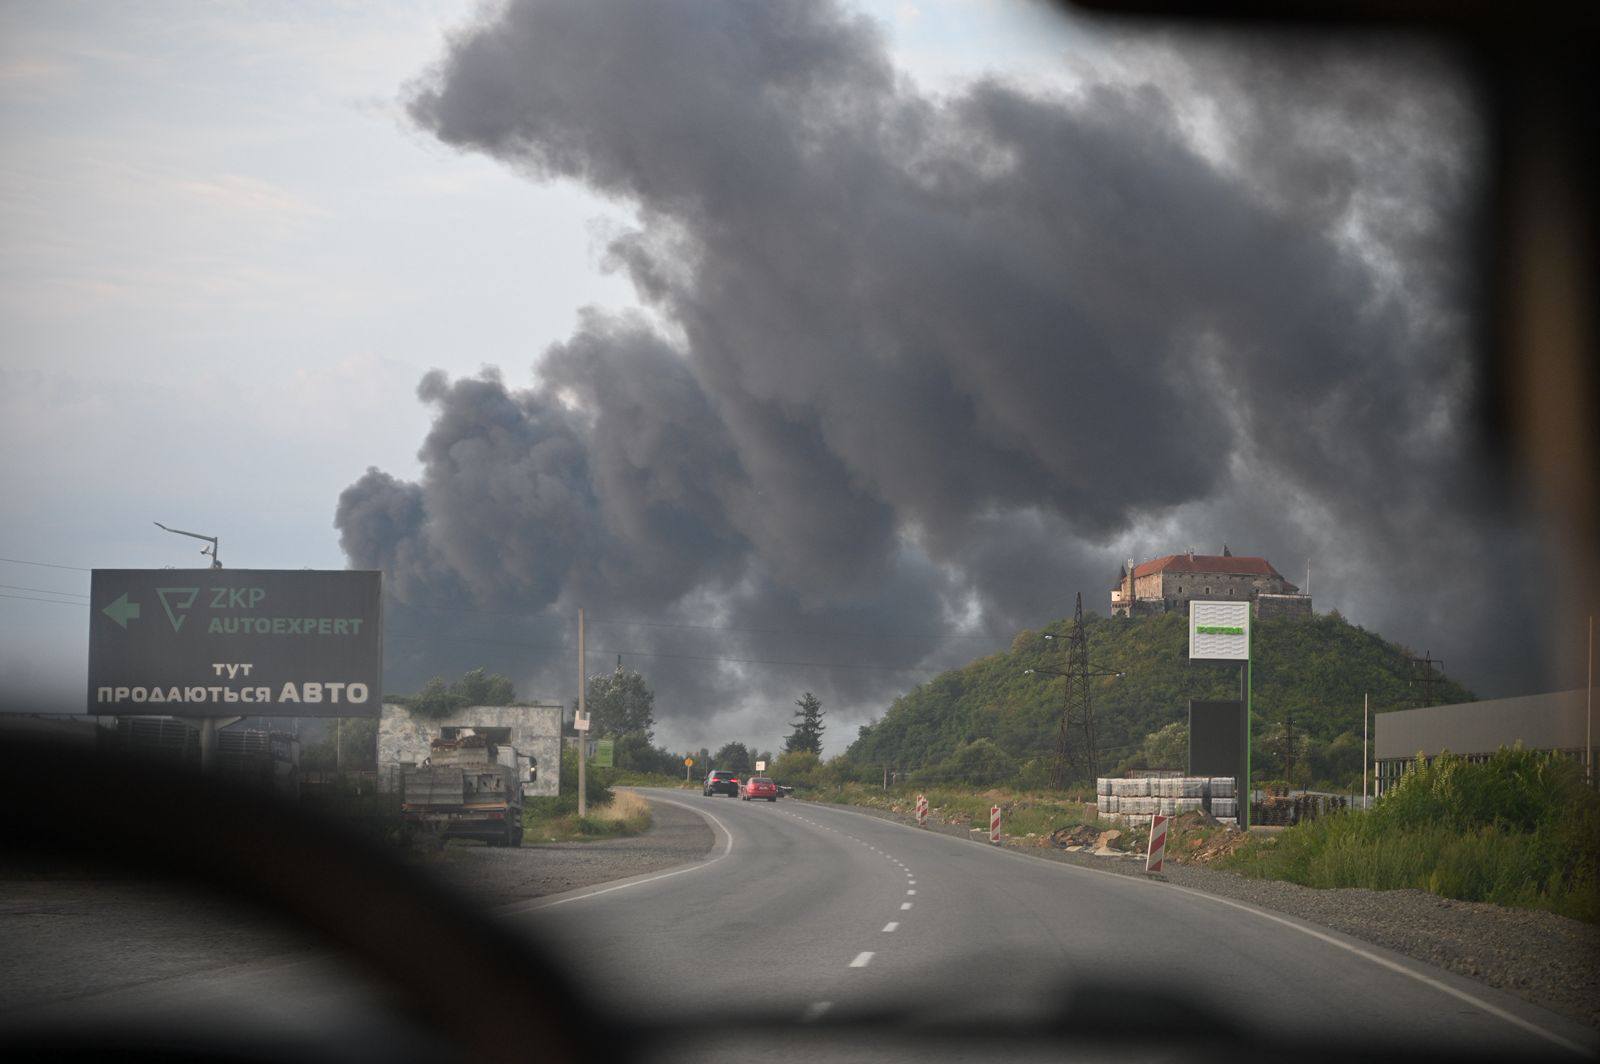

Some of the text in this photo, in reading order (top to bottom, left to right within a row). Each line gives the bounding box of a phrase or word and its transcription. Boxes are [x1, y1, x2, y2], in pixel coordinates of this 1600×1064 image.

[208, 587, 266, 609] ZKP
[208, 617, 364, 635] AUTOEXPERT
[97, 682, 369, 704] ПРОДАЮТЬСЯ АВТО
